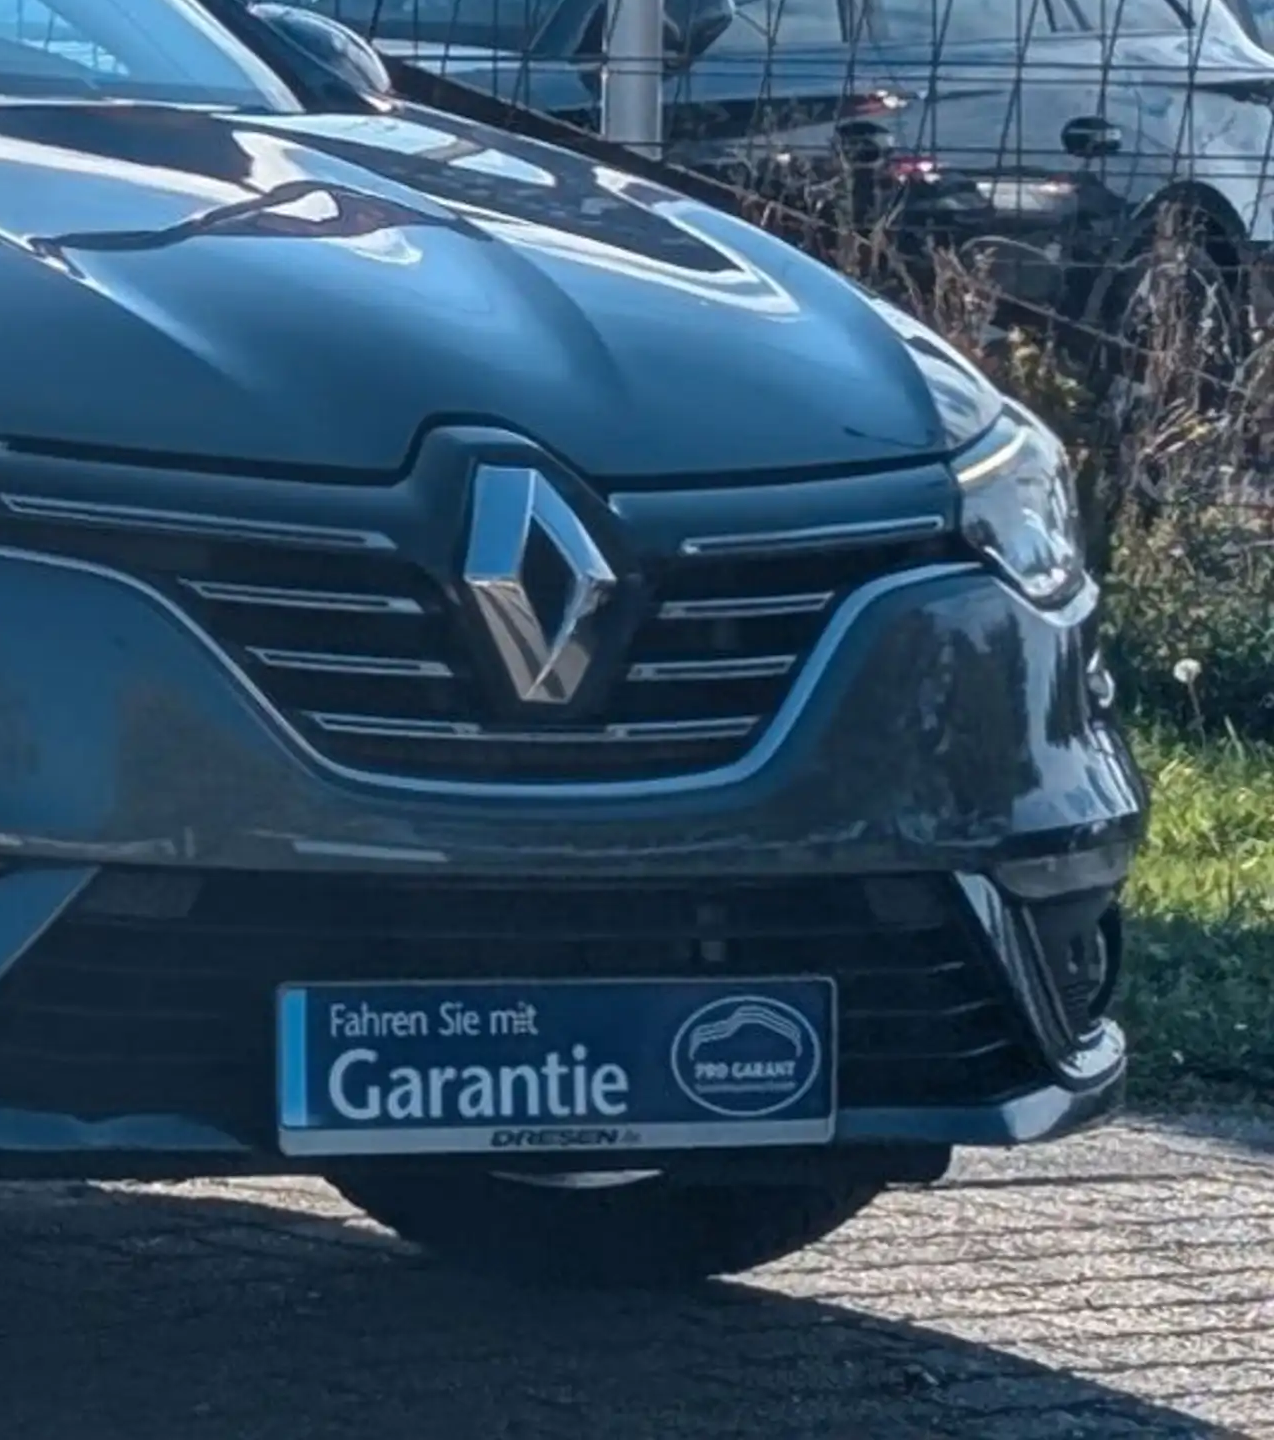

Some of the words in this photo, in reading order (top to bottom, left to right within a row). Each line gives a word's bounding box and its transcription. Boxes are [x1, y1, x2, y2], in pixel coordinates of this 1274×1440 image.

[330, 1001, 429, 1037] Fahren
[438, 1001, 481, 1036] Sie
[490, 1001, 540, 1036] mit
[328, 1044, 629, 1120] Garantie
